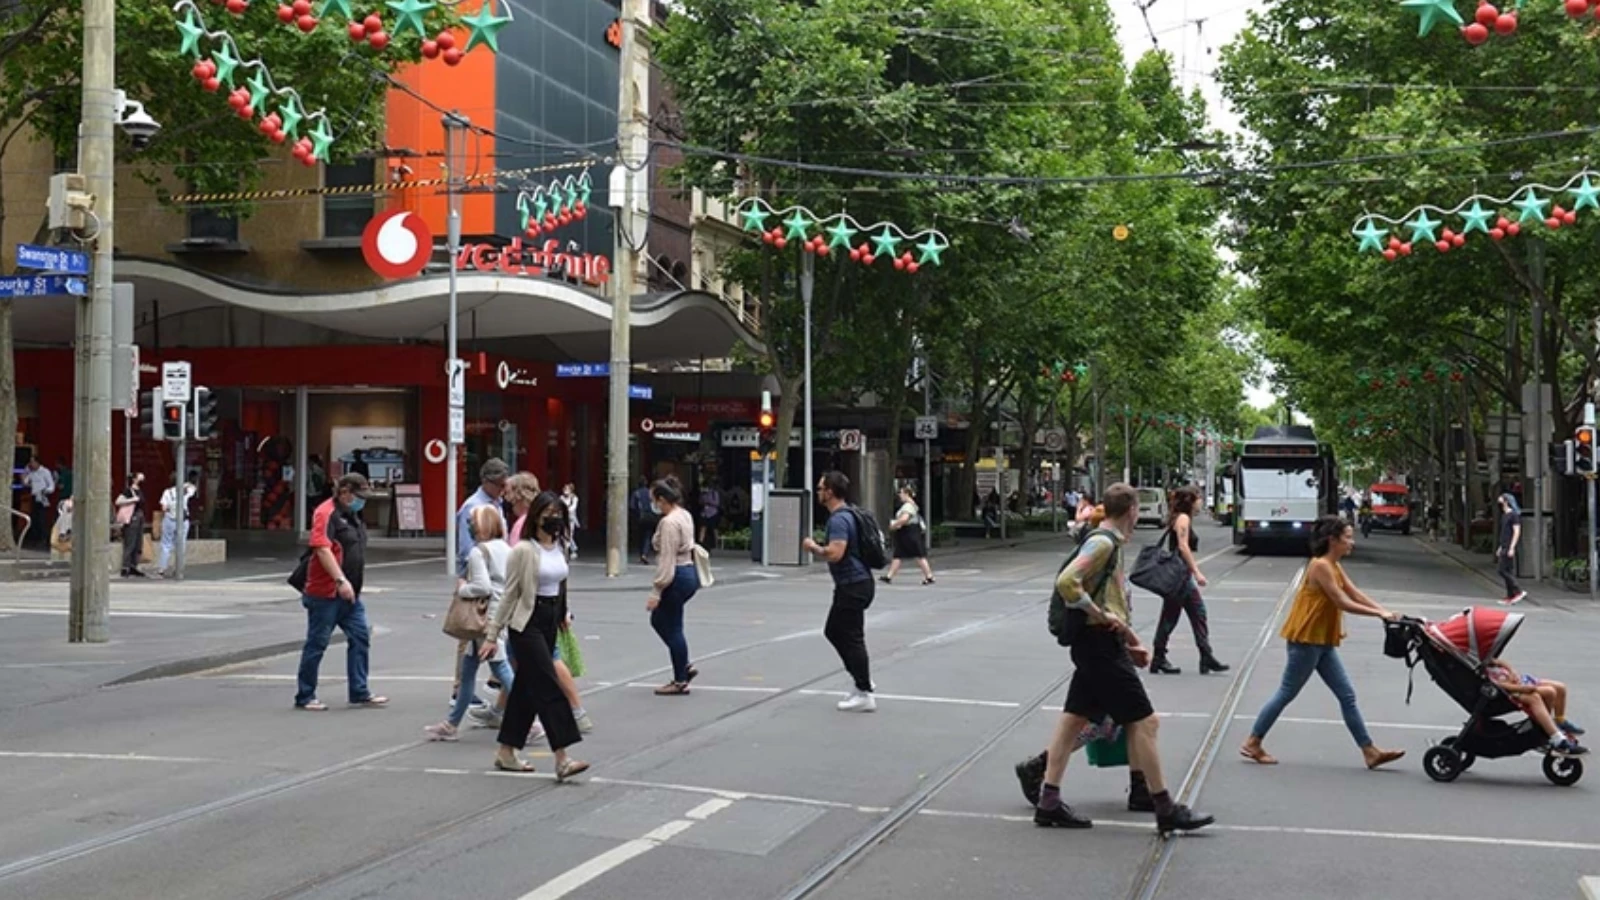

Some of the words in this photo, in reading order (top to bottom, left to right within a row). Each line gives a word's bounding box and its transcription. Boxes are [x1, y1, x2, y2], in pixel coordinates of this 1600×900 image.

[20, 245, 59, 264] Swanston
[60, 251, 69, 264] St
[456, 236, 610, 285] vodafone
[0, 277, 30, 290] ourke
[35, 277, 46, 290] St
[655, 421, 689, 429] vodafone
